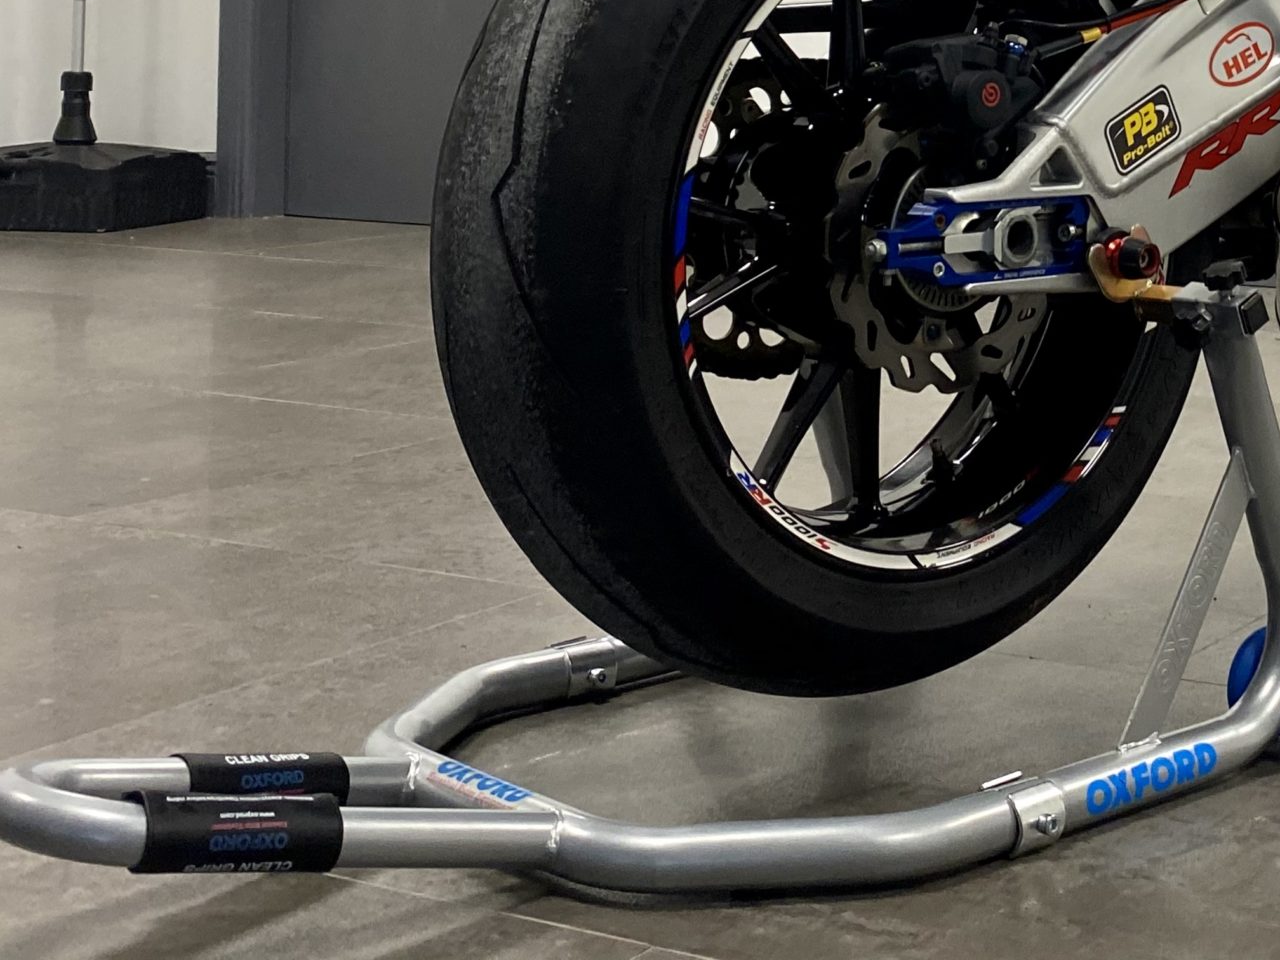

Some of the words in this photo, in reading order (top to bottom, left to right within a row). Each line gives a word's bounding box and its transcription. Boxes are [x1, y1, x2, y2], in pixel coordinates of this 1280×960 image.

[1221, 41, 1268, 80] HEL
[1123, 101, 1159, 147] PB
[225, 755, 269, 765] CLEAN
[242, 770, 304, 789] OXFORD
[1086, 742, 1218, 816] OXFORD
[209, 833, 288, 852] OXFORD
